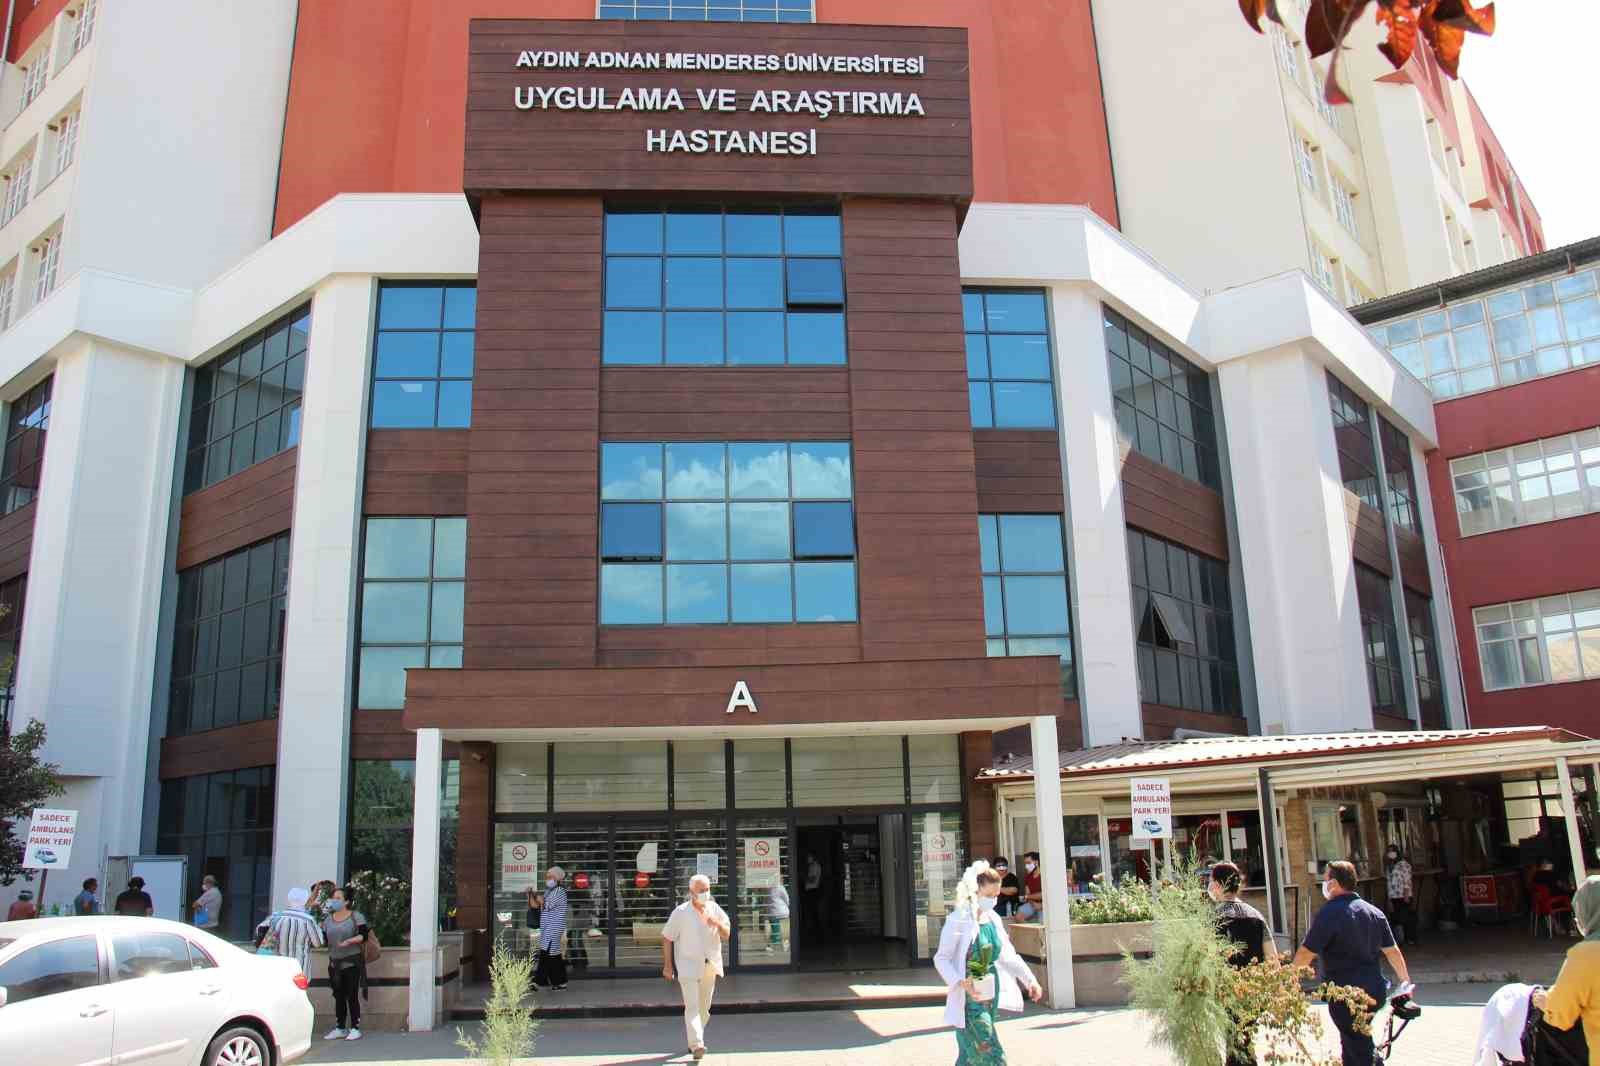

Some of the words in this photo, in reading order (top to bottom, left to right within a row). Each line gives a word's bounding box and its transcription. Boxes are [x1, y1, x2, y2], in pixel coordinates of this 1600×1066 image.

[515, 51, 580, 67] AYDIN
[585, 51, 660, 69] ADNAN
[665, 53, 781, 71] MENDERES
[784, 53, 924, 74] ÜNİVERSİTESİ
[514, 86, 685, 111] UYGULAMA
[696, 88, 736, 112] VE
[750, 90, 926, 119] ARAŞTIRMA
[646, 128, 817, 155] HASTANESİ
[726, 681, 758, 713] A
[1137, 783, 1163, 791] SADECE
[1132, 795, 1170, 803] AMBULANS
[1134, 807, 1152, 815] PARK
[31, 826, 74, 834] AMBULANS
[30, 837, 50, 845] PARK
